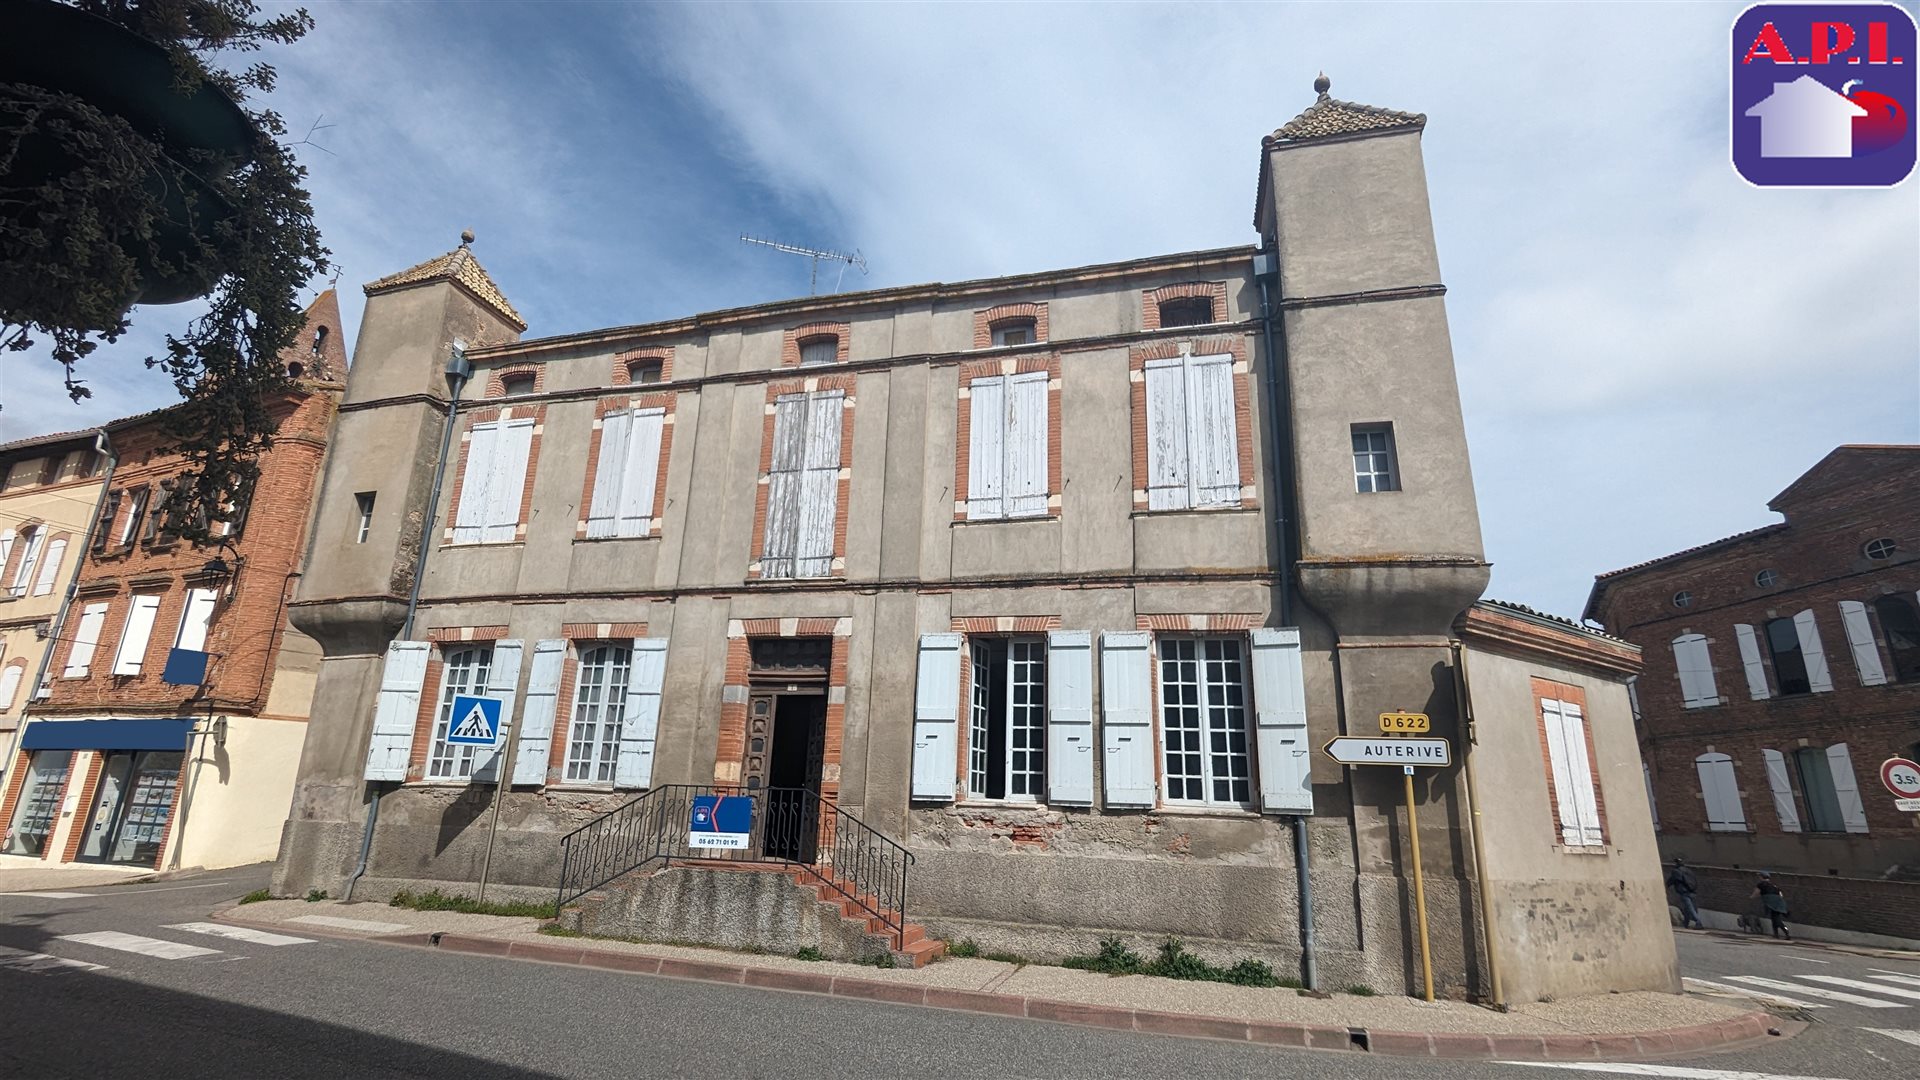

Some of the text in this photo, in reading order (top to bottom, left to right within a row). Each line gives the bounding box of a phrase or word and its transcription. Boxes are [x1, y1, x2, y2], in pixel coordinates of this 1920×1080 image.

[1383, 717, 1426, 729] D 622
[1364, 745, 1443, 758] AUTERIVE
